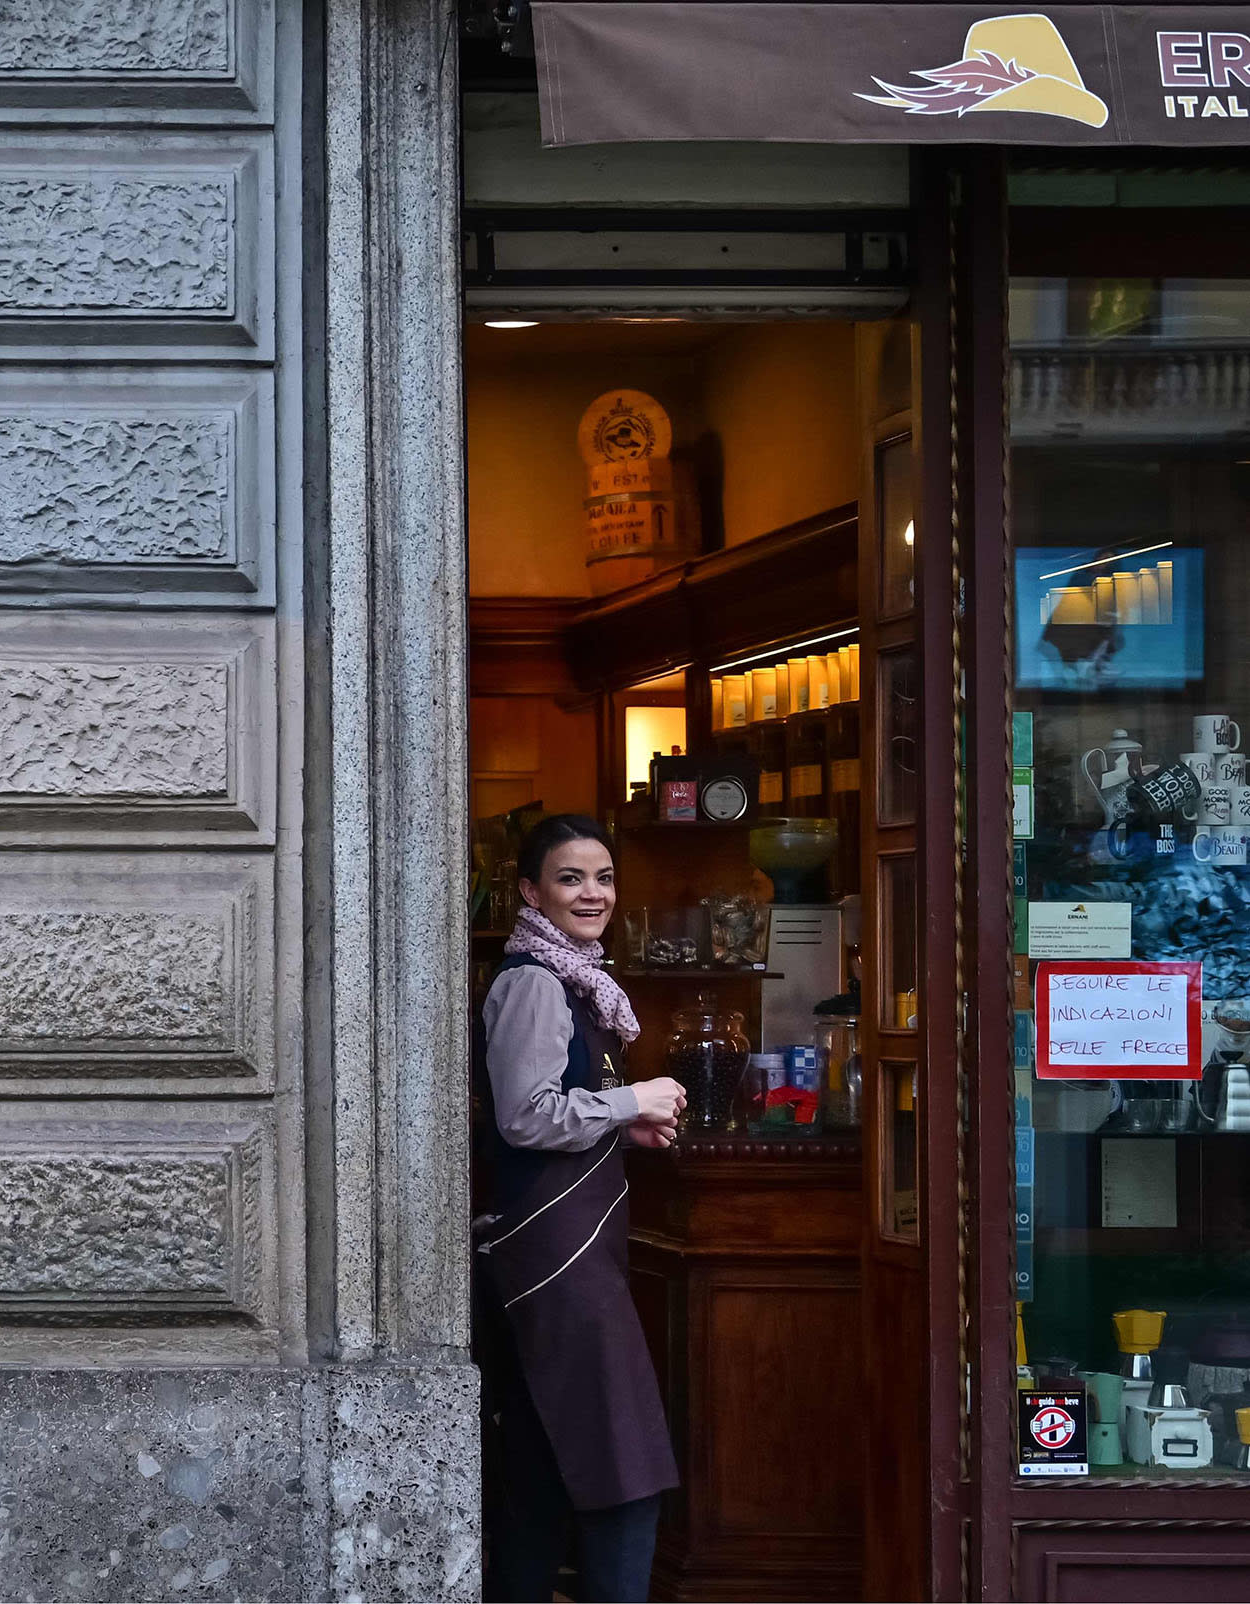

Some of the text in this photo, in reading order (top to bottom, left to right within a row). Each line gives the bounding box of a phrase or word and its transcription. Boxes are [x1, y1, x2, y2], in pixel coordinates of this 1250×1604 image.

[1159, 824, 1174, 838] THE
[1156, 839, 1175, 854] BOSS
[1049, 976, 1173, 992] SEGUIRE LE
[1052, 1004, 1173, 1023] INDICAZIONI
[1050, 1039, 1188, 1056] DELLE FRECCE
